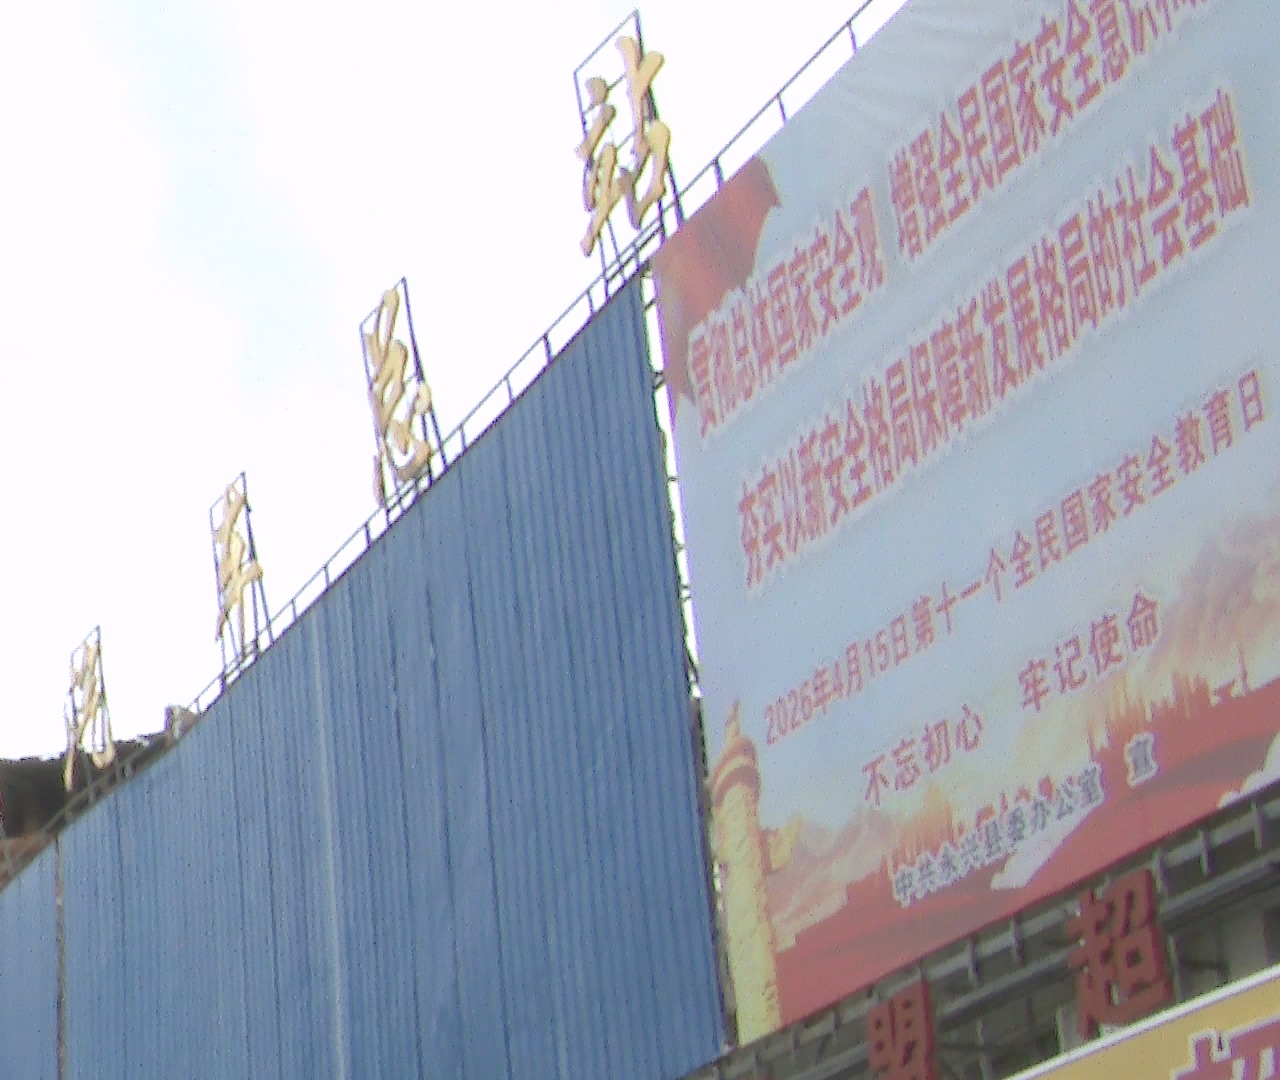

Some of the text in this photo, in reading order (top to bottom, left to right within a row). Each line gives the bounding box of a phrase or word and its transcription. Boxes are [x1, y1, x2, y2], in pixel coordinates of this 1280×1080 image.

[862, 592, 1160, 804] 不忘初心 牢记使命
